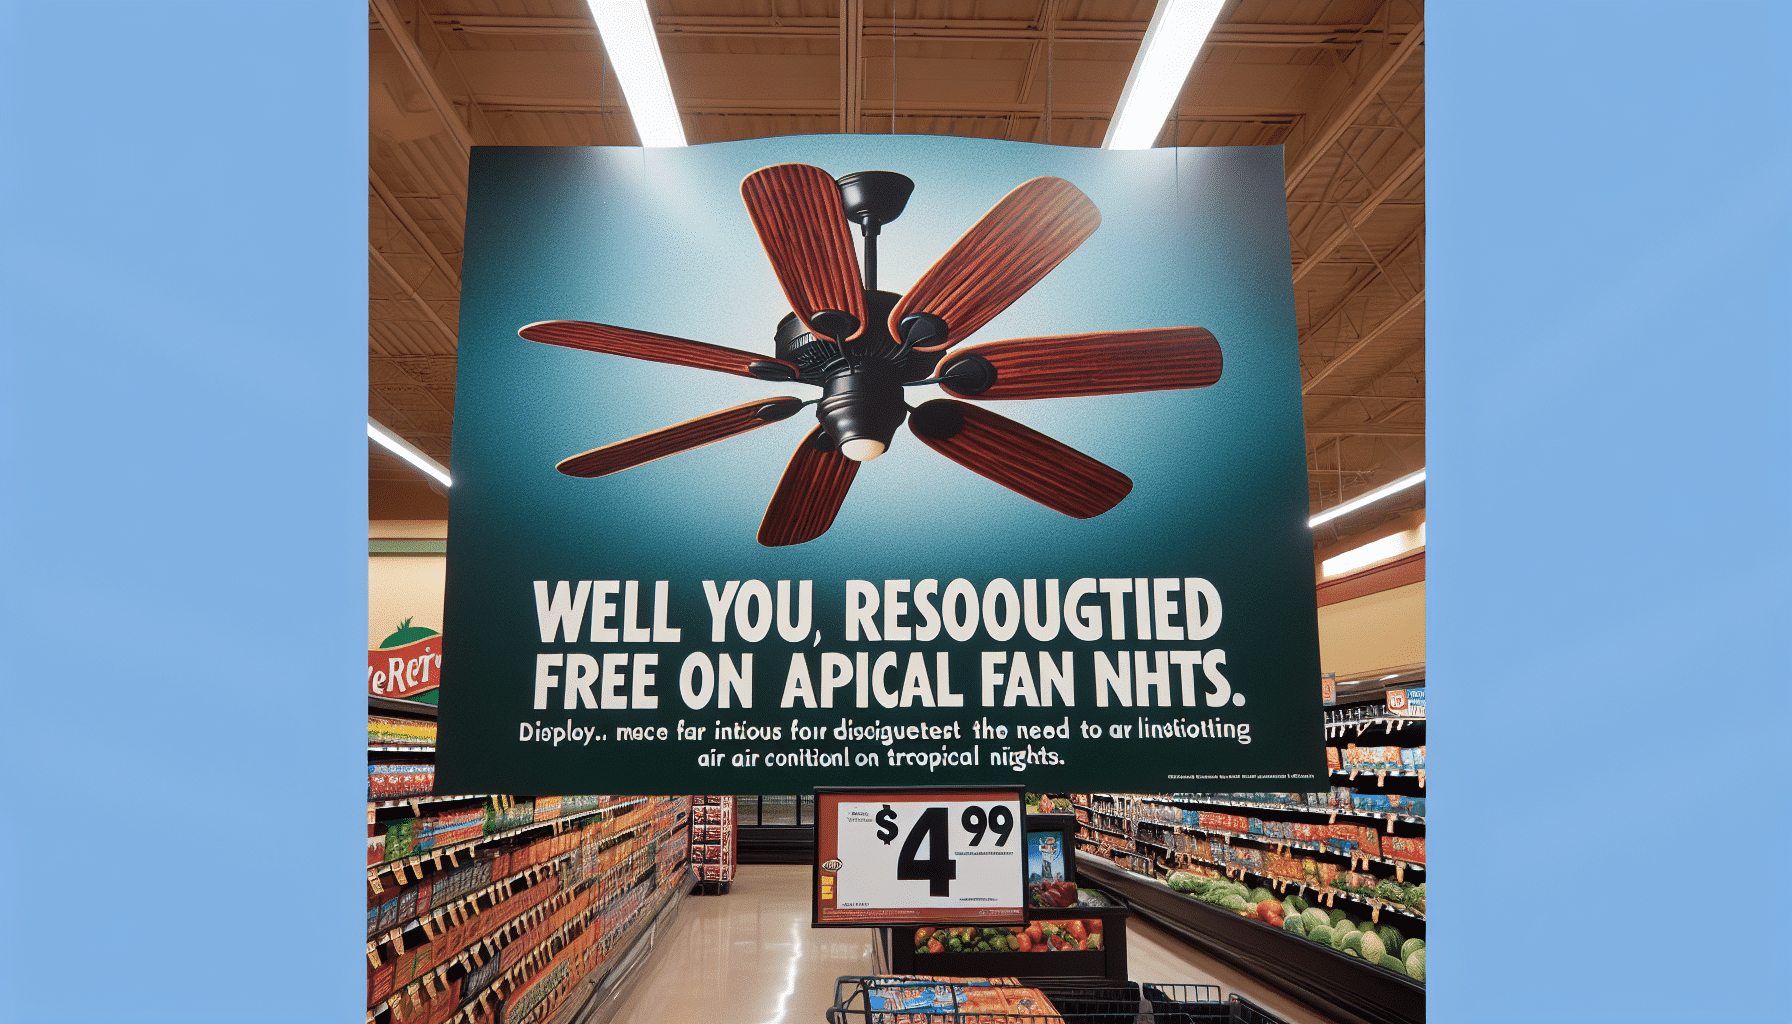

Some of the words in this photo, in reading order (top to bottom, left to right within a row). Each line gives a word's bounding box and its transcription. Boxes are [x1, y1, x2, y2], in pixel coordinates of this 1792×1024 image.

[533, 580, 682, 643] WELL
[702, 578, 822, 647] YOU,
[845, 577, 1223, 642] RESOOUGTIED
[533, 652, 659, 710] FREE
[679, 651, 753, 710] ON
[780, 651, 964, 709] APICAL
[981, 650, 1076, 707] FAN
[1093, 648, 1246, 708] NHTS.
[1079, 720, 1103, 739] to
[697, 748, 726, 768] air
[731, 748, 760, 768] air
[854, 752, 880, 768] on
